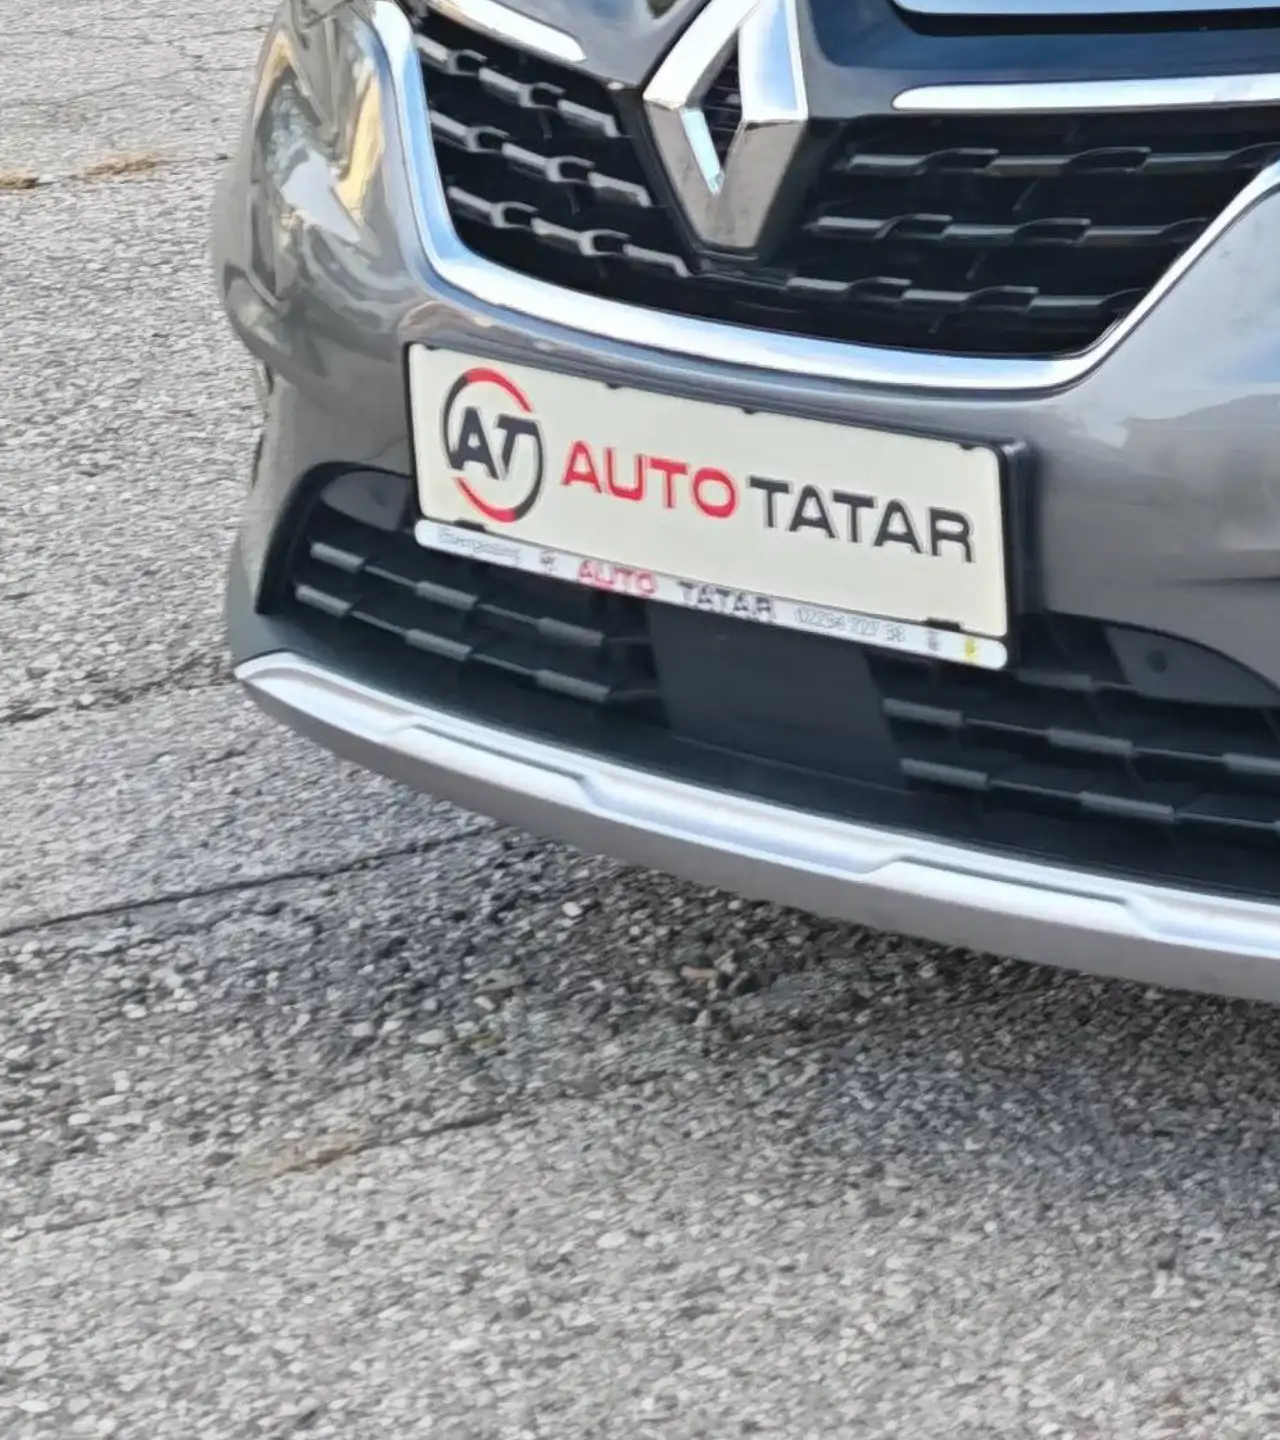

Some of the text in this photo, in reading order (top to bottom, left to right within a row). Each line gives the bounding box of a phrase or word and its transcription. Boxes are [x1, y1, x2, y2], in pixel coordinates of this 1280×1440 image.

[561, 440, 975, 563] AUTO TATAR
[577, 558, 659, 597] AUTO
[677, 579, 776, 620] TATAR
